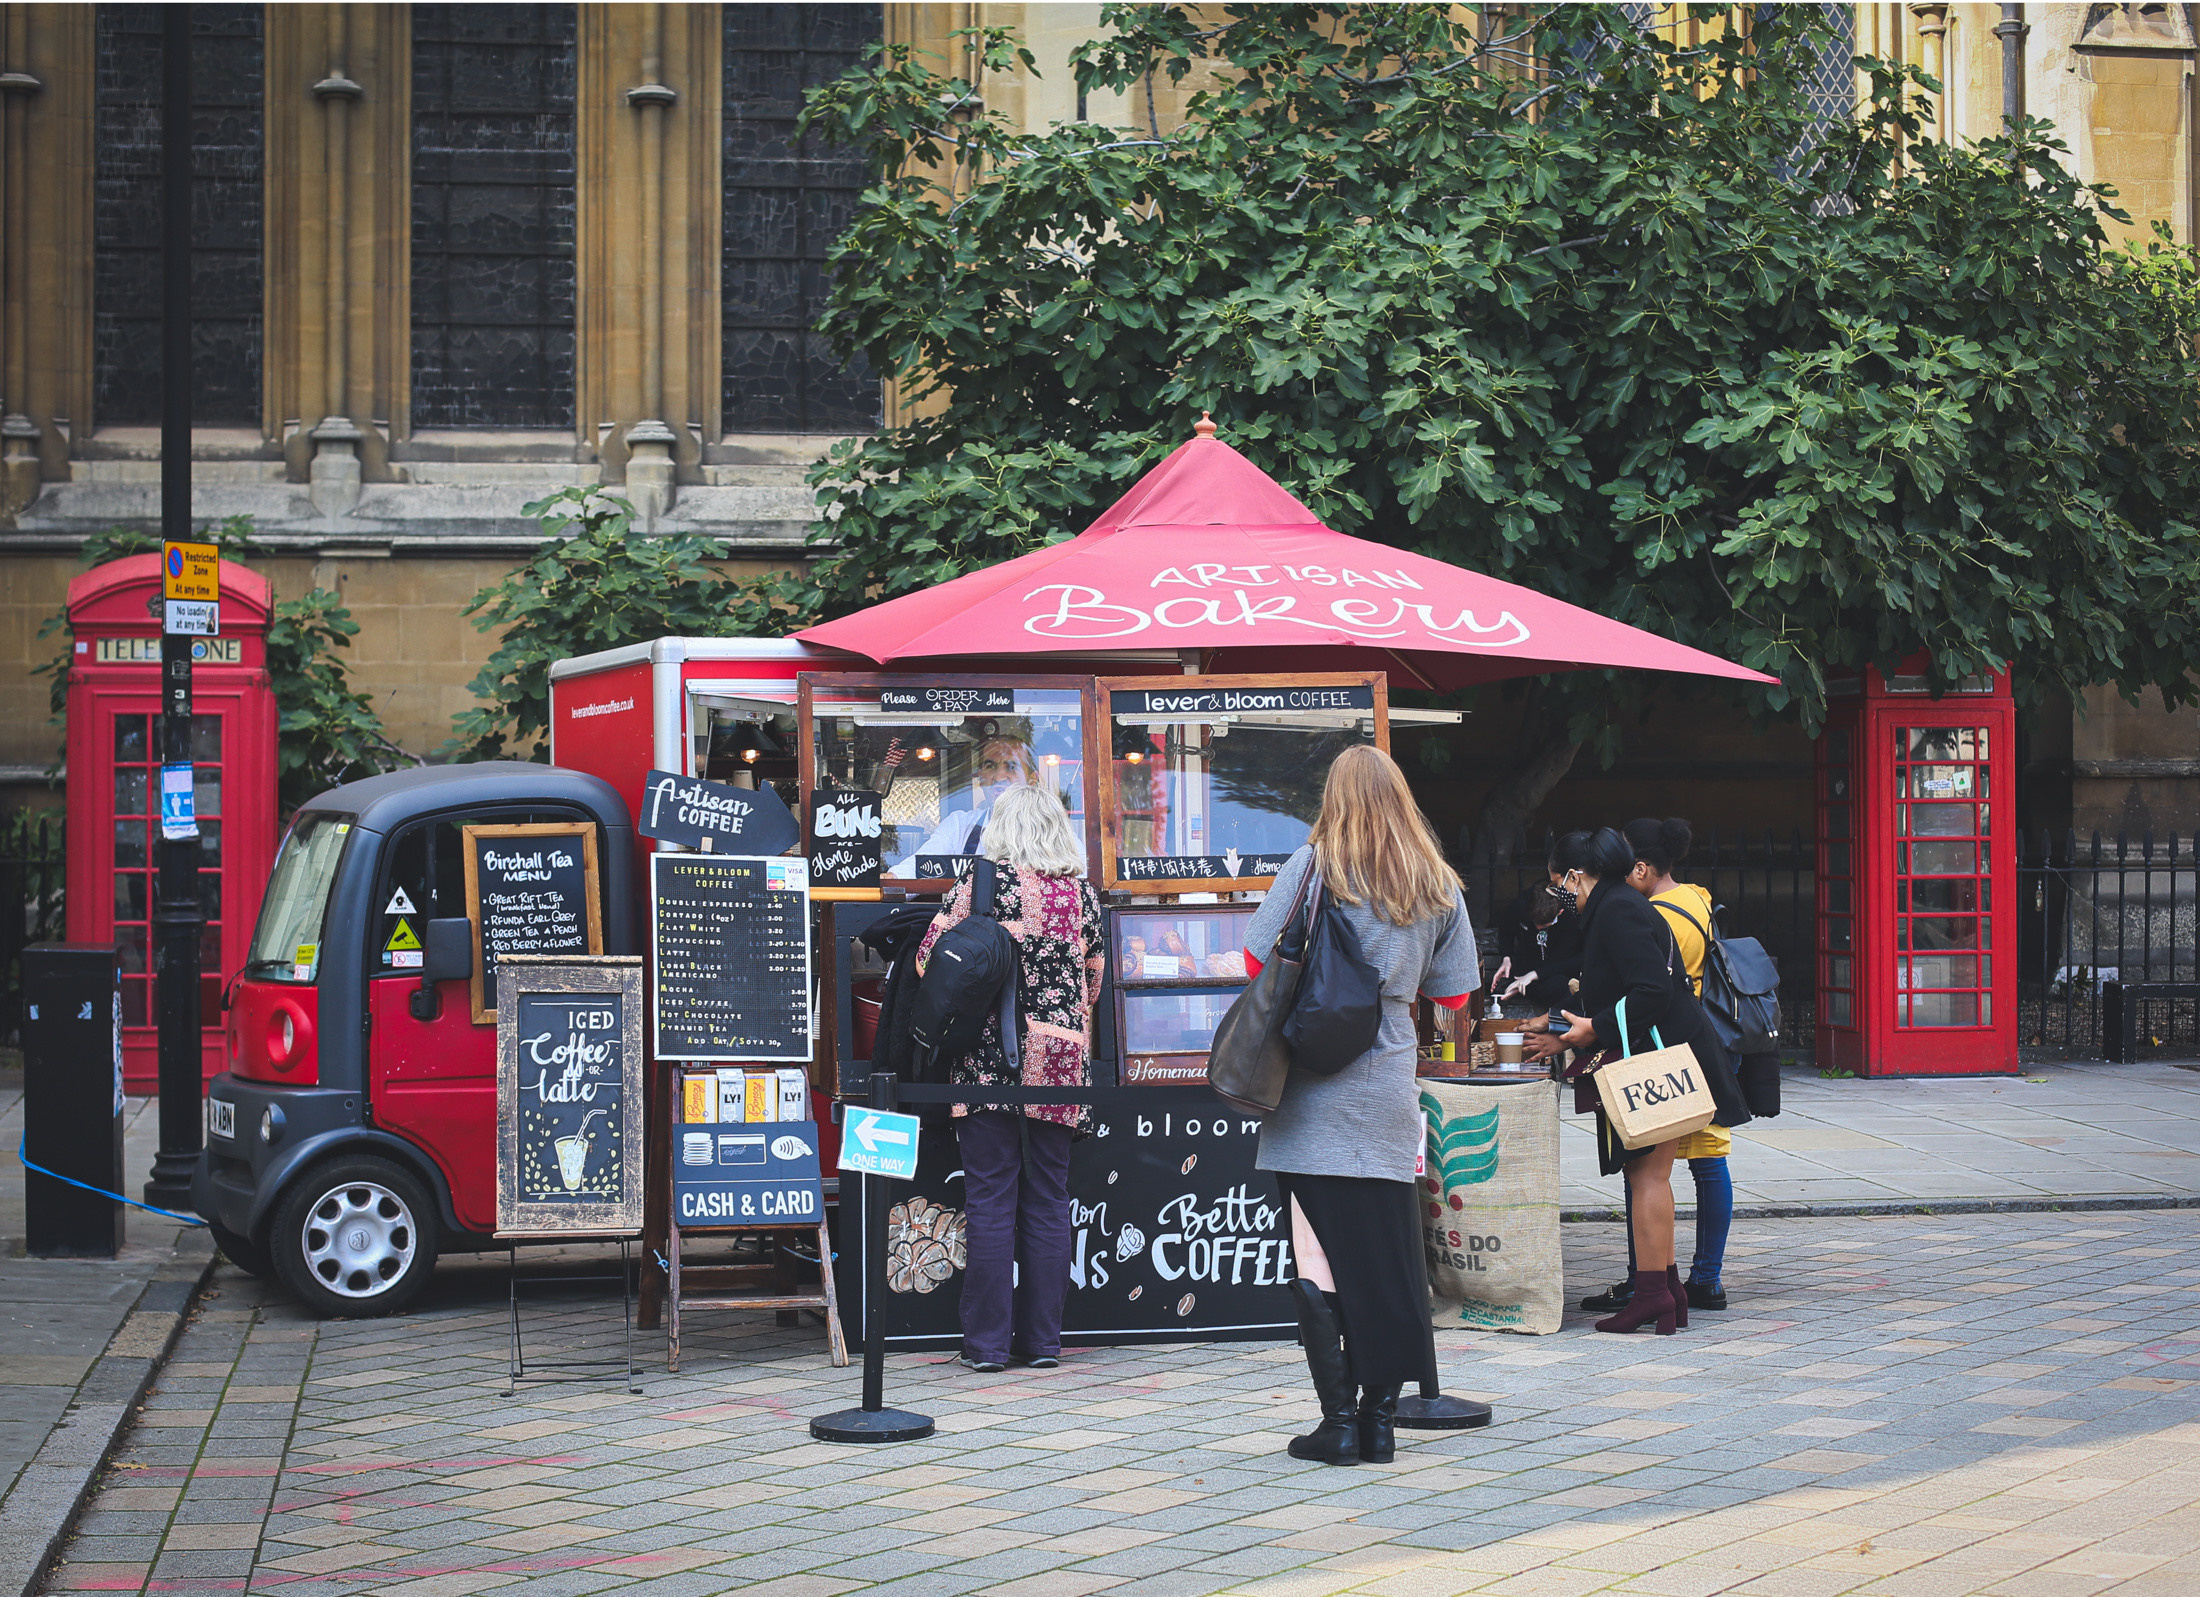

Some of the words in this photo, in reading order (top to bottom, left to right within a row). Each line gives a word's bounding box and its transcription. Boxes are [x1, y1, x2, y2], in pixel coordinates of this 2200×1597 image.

[185, 552, 216, 564] Restricted
[194, 565, 208, 576] Zone
[1151, 563, 1423, 591] ARTISAN
[175, 584, 182, 594] At
[184, 586, 195, 596] any
[196, 584, 210, 595] time
[176, 606, 186, 616] No
[1023, 584, 1531, 647] Bakery
[176, 620, 182, 629] at
[184, 622, 194, 631] any
[196, 620, 206, 629] tim
[100, 639, 238, 660] TELEONE
[881, 692, 918, 704] Please
[925, 688, 982, 702] ORDER
[986, 692, 1011, 706] Here
[1289, 690, 1351, 708] COFFEE
[943, 700, 973, 712] PAY
[648, 777, 753, 829] Artisan
[836, 792, 860, 804] ALL
[678, 805, 744, 835] COFFEE
[483, 850, 542, 871] Birchall
[547, 850, 574, 869] Tea
[811, 850, 853, 878] Home
[674, 866, 705, 876] LEVER
[708, 867, 714, 876] &
[718, 868, 750, 877] BLOOM
[836, 854, 878, 883] Made
[503, 870, 552, 882] MENU
[696, 880, 734, 889] COFFEE
[488, 892, 517, 906] GREAT
[518, 892, 542, 904] RIFT
[544, 891, 564, 902] TEA
[659, 897, 697, 906] DOUBLE
[702, 900, 753, 908] ESPRESSO
[528, 913, 551, 924] EARL
[551, 910, 576, 922] GREY
[659, 910, 704, 920] CORTADO
[491, 928, 520, 938] GREEN
[522, 926, 540, 937] TEA
[552, 924, 578, 935] PEACH
[659, 922, 684, 931] FLAT
[690, 924, 721, 932] WHITE
[492, 940, 511, 951] RED
[511, 939, 542, 950] BERRY
[659, 935, 722, 946] CAPPUCCINO
[659, 948, 690, 957] LATTE
[660, 961, 684, 970] LONG
[690, 962, 722, 970] BLACK
[662, 970, 718, 979] AMERICANO
[660, 984, 694, 993] MOCHA
[660, 997, 684, 1006] ICED
[690, 998, 729, 1007] COFFEE
[568, 1010, 614, 1030] ICED
[660, 1010, 679, 1018] HOT
[684, 1010, 742, 1020] CHOCOLATE
[660, 1023, 704, 1032] PYRAMID
[687, 1036, 706, 1045] ADD
[530, 1069, 610, 1102] latte
[1620, 1068, 1698, 1113] F&M
[1097, 1124, 1110, 1138] &
[852, 1152, 878, 1168] ONE
[880, 1157, 906, 1172] WAY
[682, 1192, 734, 1217] CASH
[741, 1194, 756, 1216] &
[762, 1190, 814, 1216] CARD
[1157, 1183, 1283, 1242] Better
[1468, 1235, 1502, 1252] DO
[1151, 1233, 1295, 1286] COFFEE
